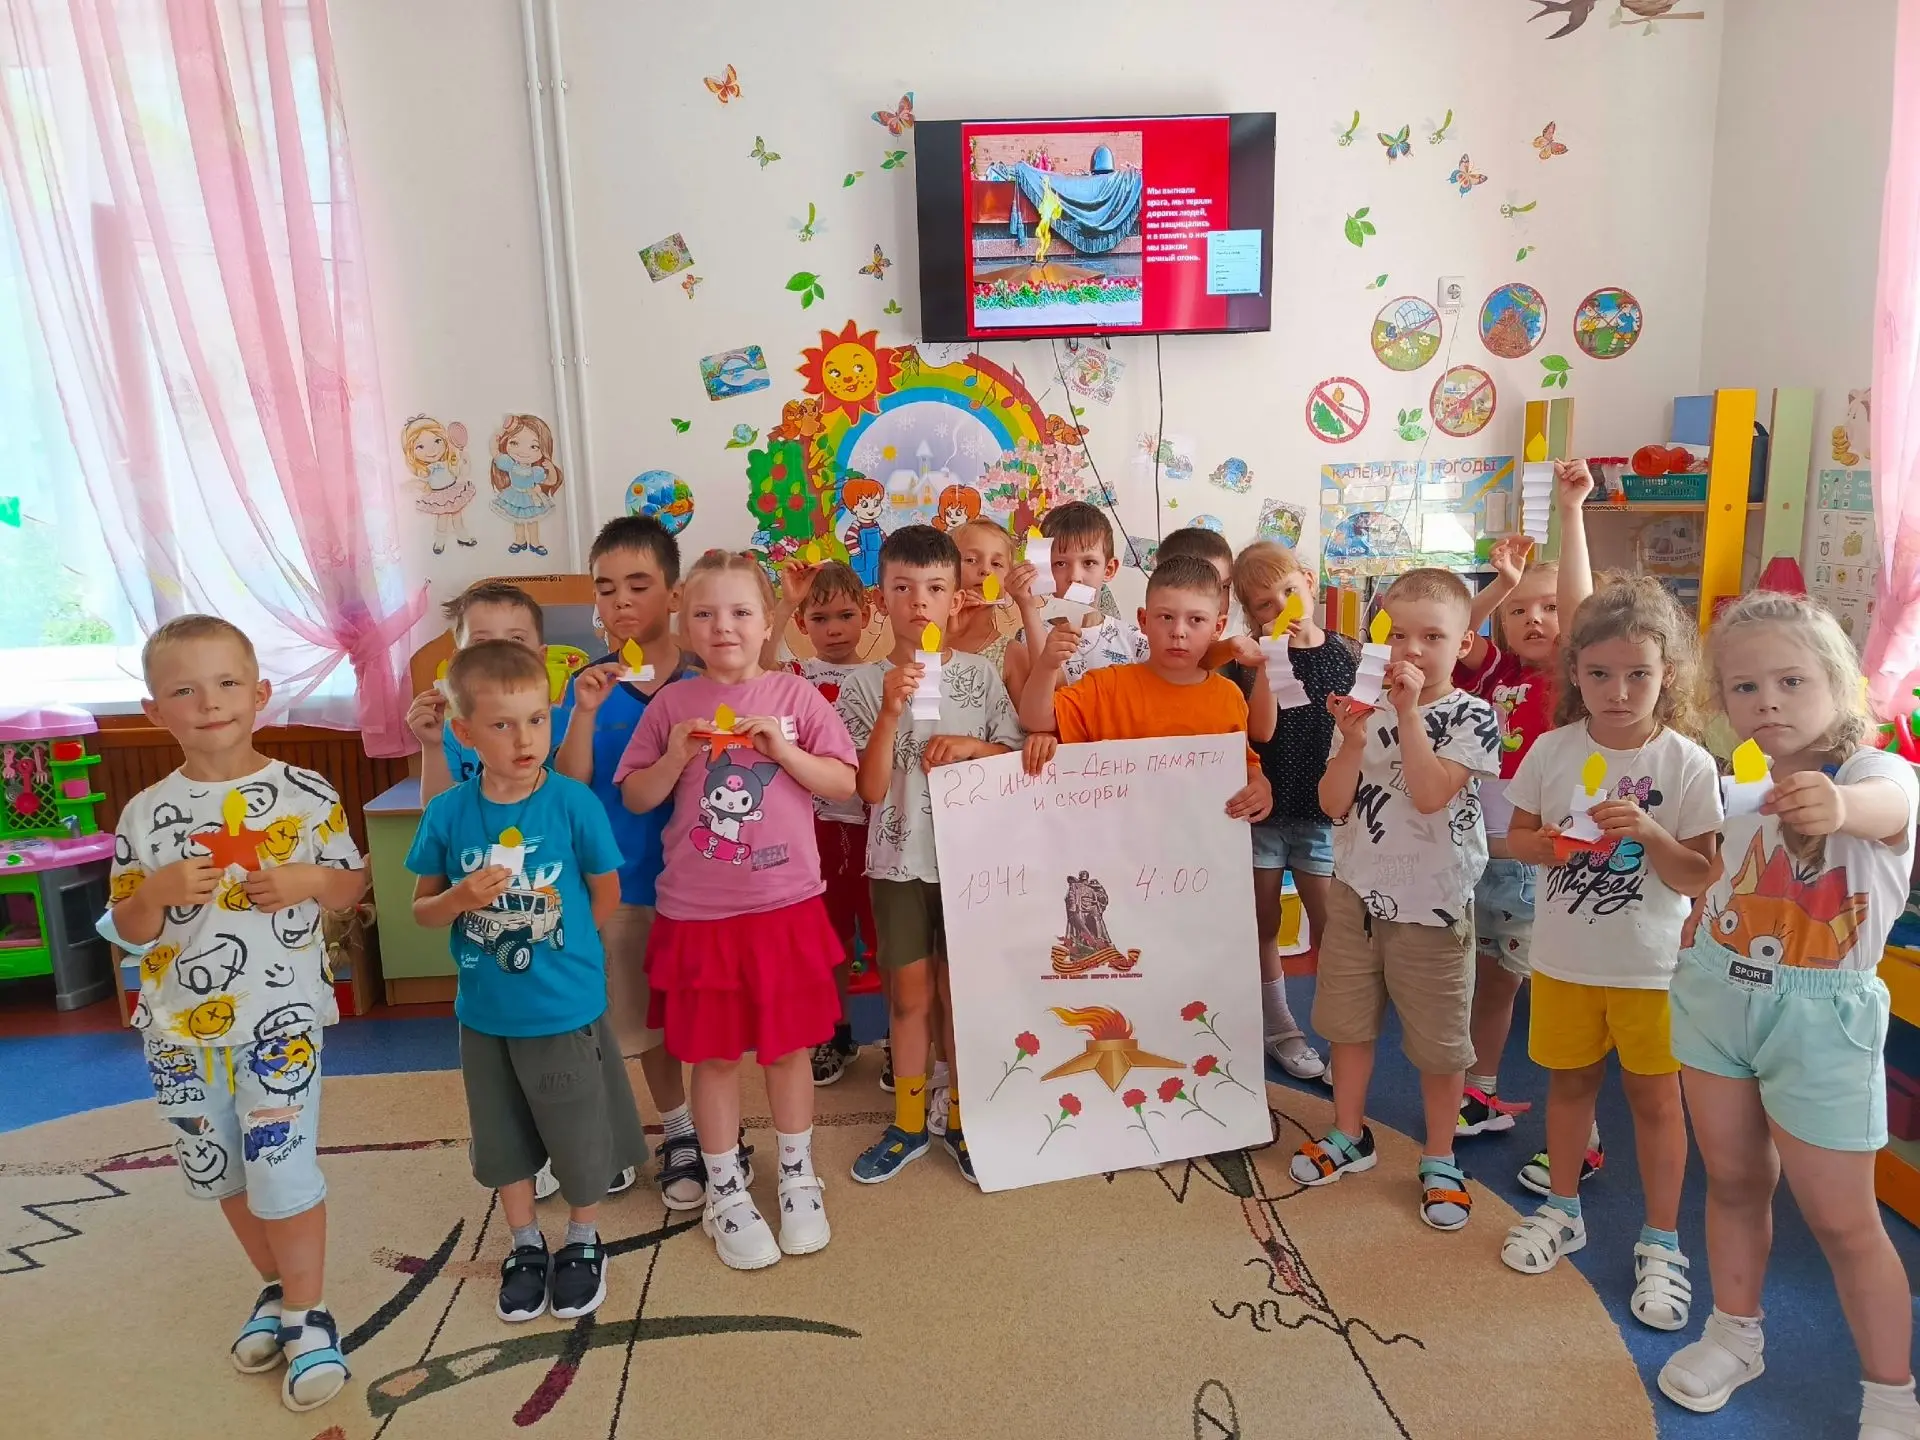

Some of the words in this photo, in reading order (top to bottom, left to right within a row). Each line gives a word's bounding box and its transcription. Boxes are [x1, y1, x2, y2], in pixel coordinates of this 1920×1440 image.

[1147, 187, 1161, 195] Мы
[1430, 459, 1498, 474] ПОГОДЫ
[944, 763, 989, 808] 22
[958, 863, 1028, 909] 1941
[1136, 864, 1209, 901] 4:00
[1547, 866, 1644, 915] Mickey
[1735, 965, 1767, 981] SPORT
